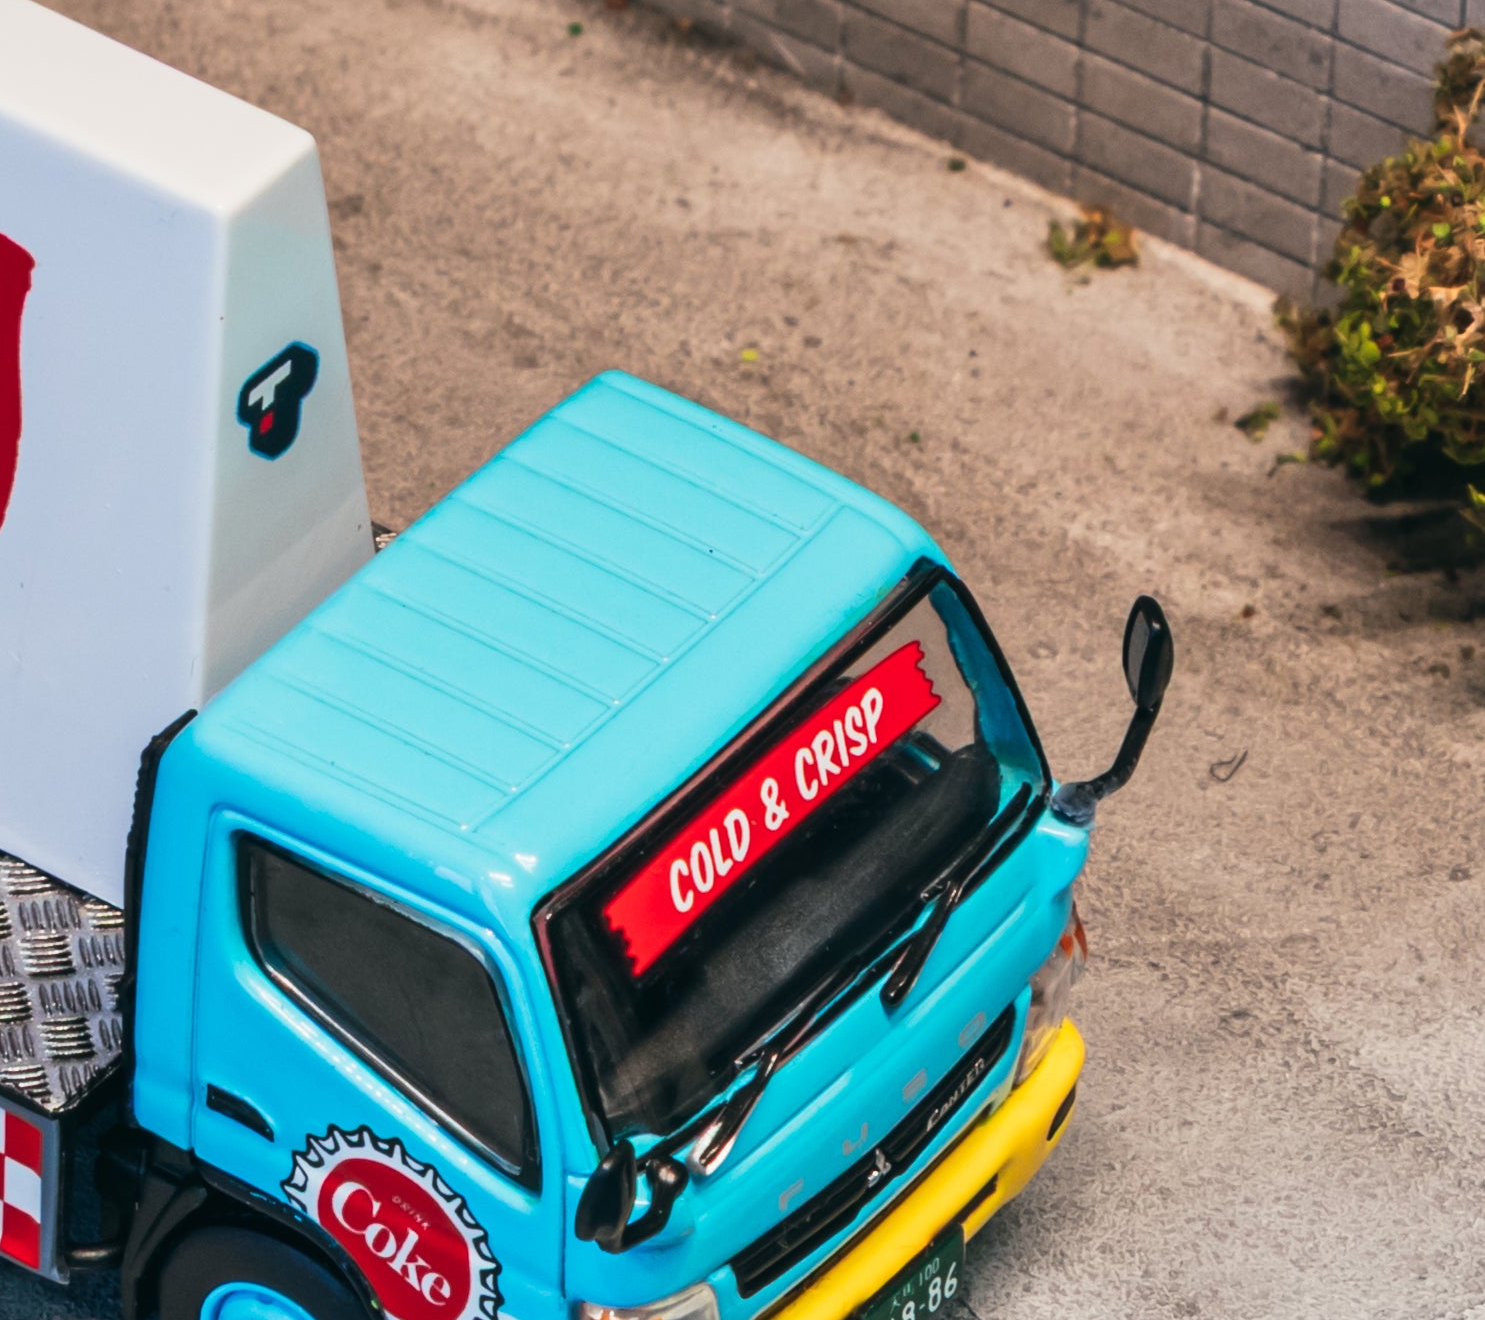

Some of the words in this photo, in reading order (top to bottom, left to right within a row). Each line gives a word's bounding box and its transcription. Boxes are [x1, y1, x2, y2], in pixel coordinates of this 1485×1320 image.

[668, 808, 751, 913] COLD
[759, 777, 790, 831] &
[794, 686, 885, 801] CRISP
[331, 1181, 452, 1307] Coke
[918, 1256, 941, 1287] 100
